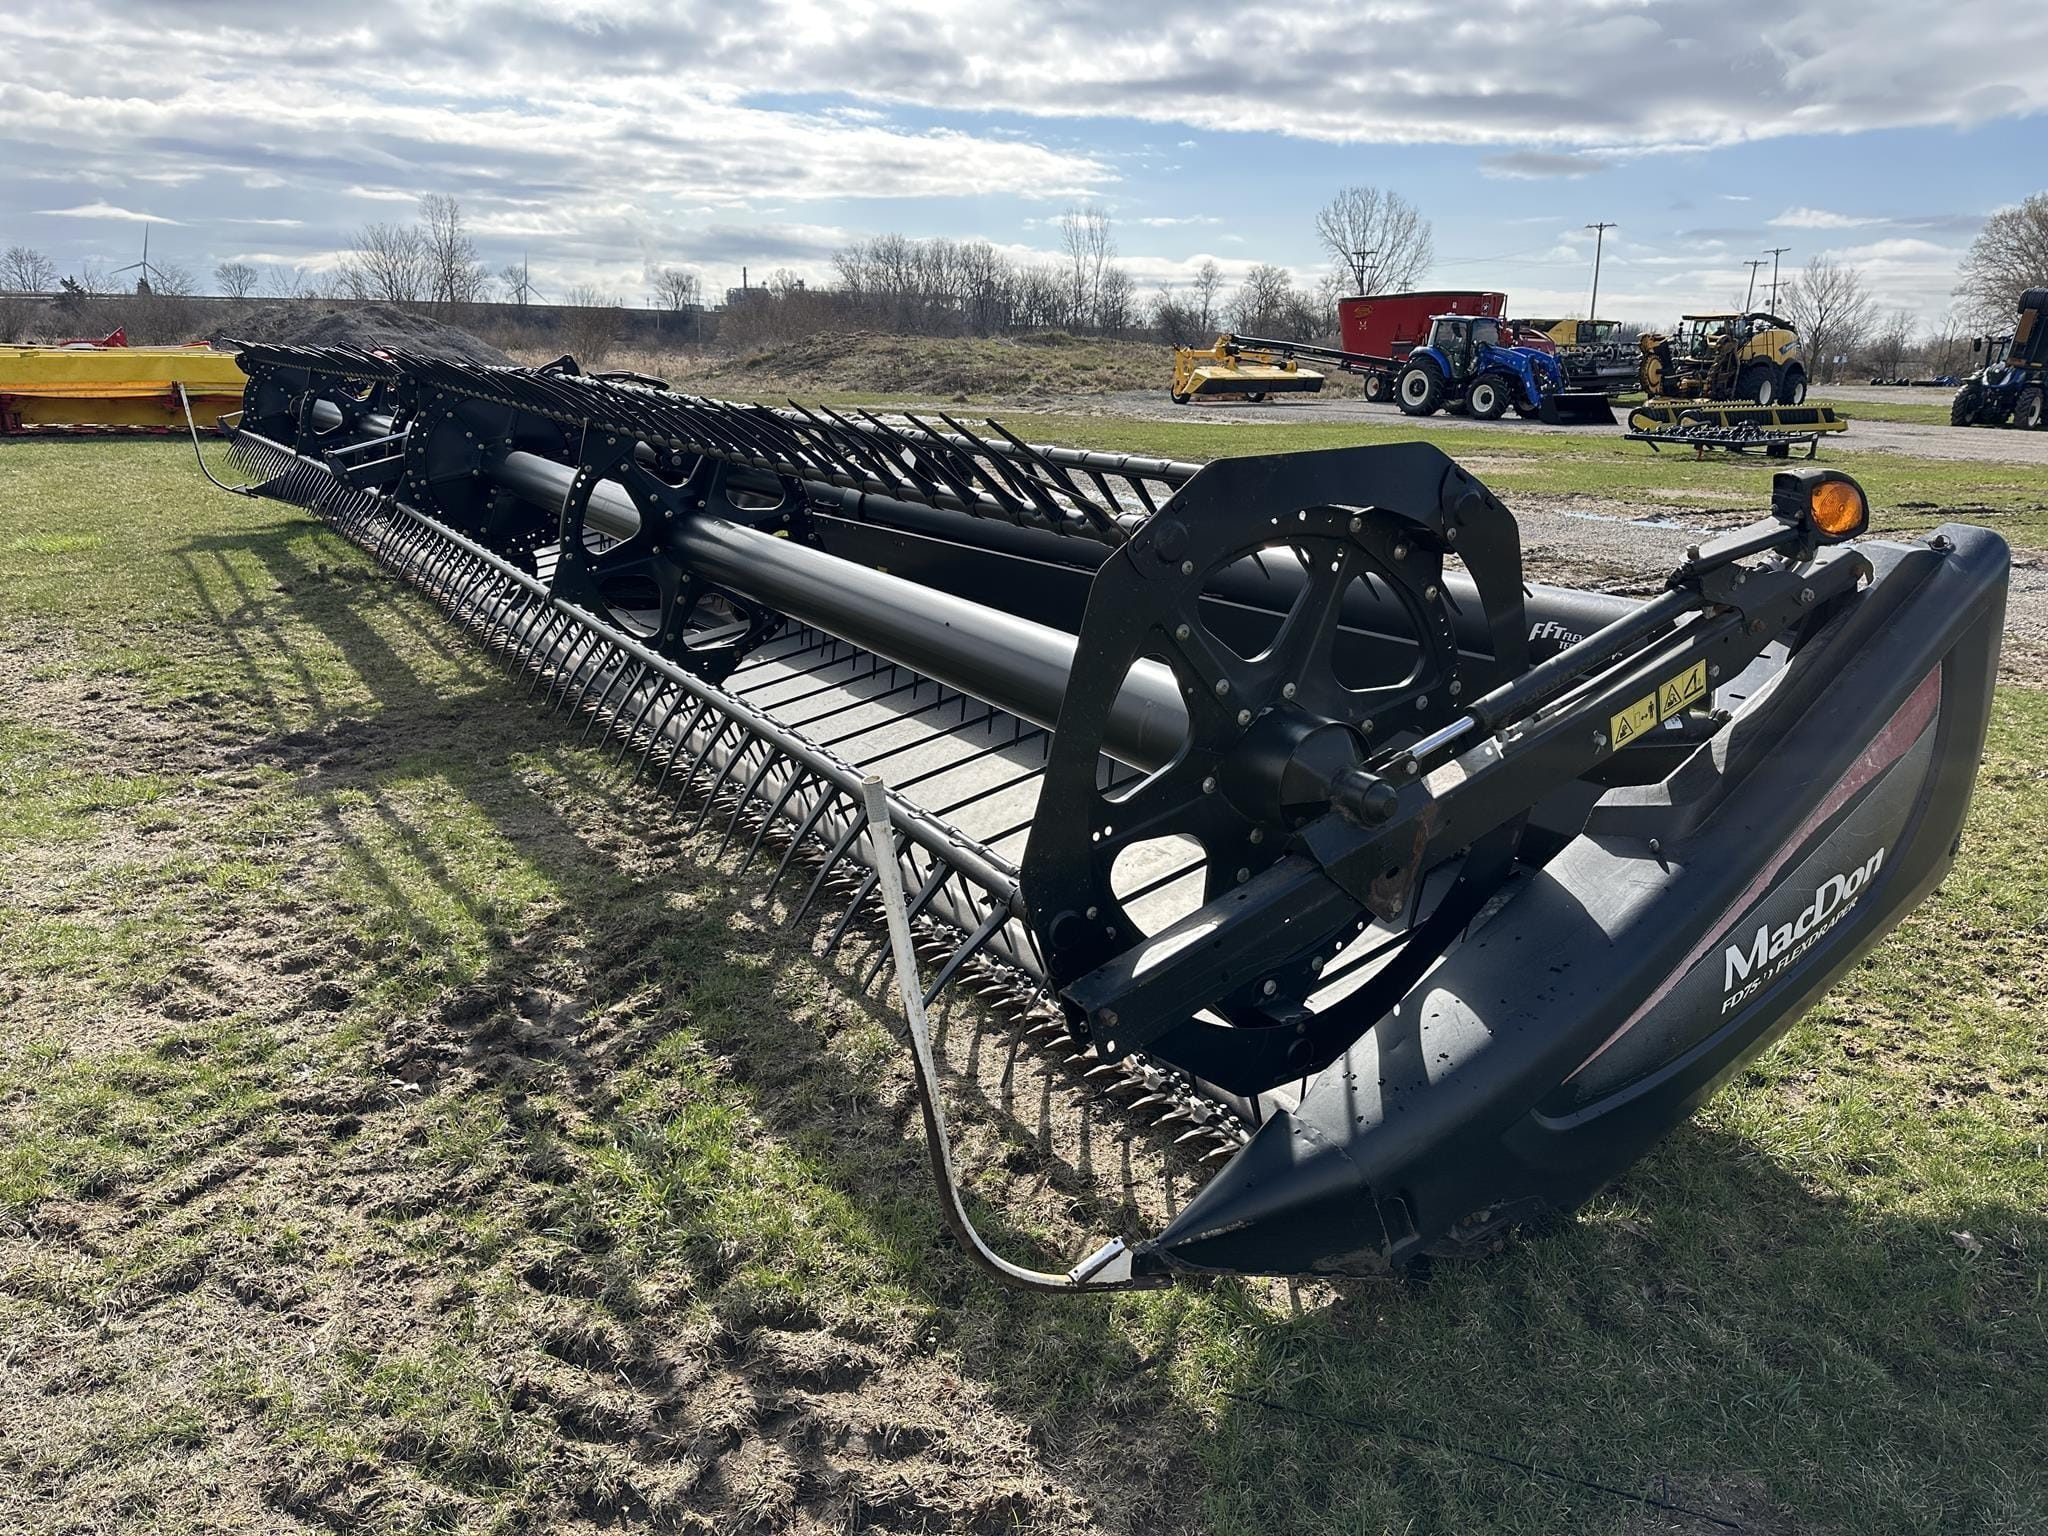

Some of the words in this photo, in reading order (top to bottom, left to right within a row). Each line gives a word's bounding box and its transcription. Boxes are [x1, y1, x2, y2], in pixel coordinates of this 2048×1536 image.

[1528, 621, 1567, 642] FFT
[1724, 847, 1885, 992] MacDon
[1775, 896, 1859, 974] FLEXDRAPER
